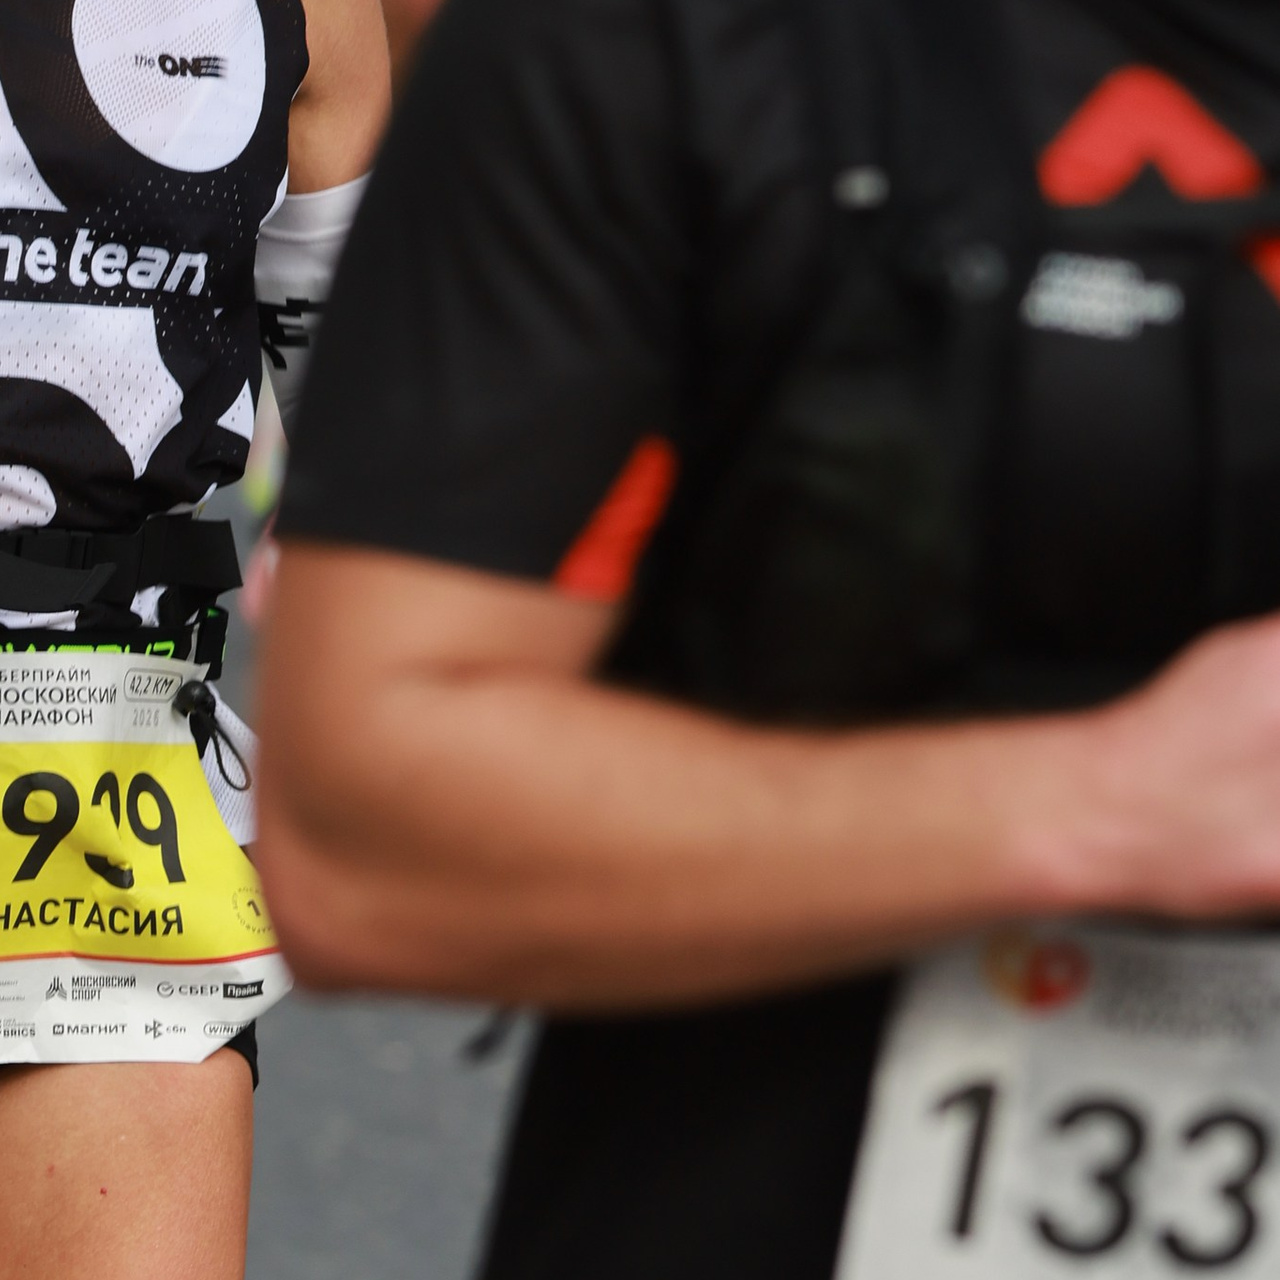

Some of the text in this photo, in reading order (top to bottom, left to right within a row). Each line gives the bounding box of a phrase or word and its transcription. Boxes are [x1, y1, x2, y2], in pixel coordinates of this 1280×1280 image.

[158, 54, 228, 77] ONE
[129, 676, 151, 696] 42,2
[71, 975, 137, 989] МОСКОВСКИЙ
[71, 988, 102, 1001] СПОРТ
[178, 984, 220, 997] СБЕР
